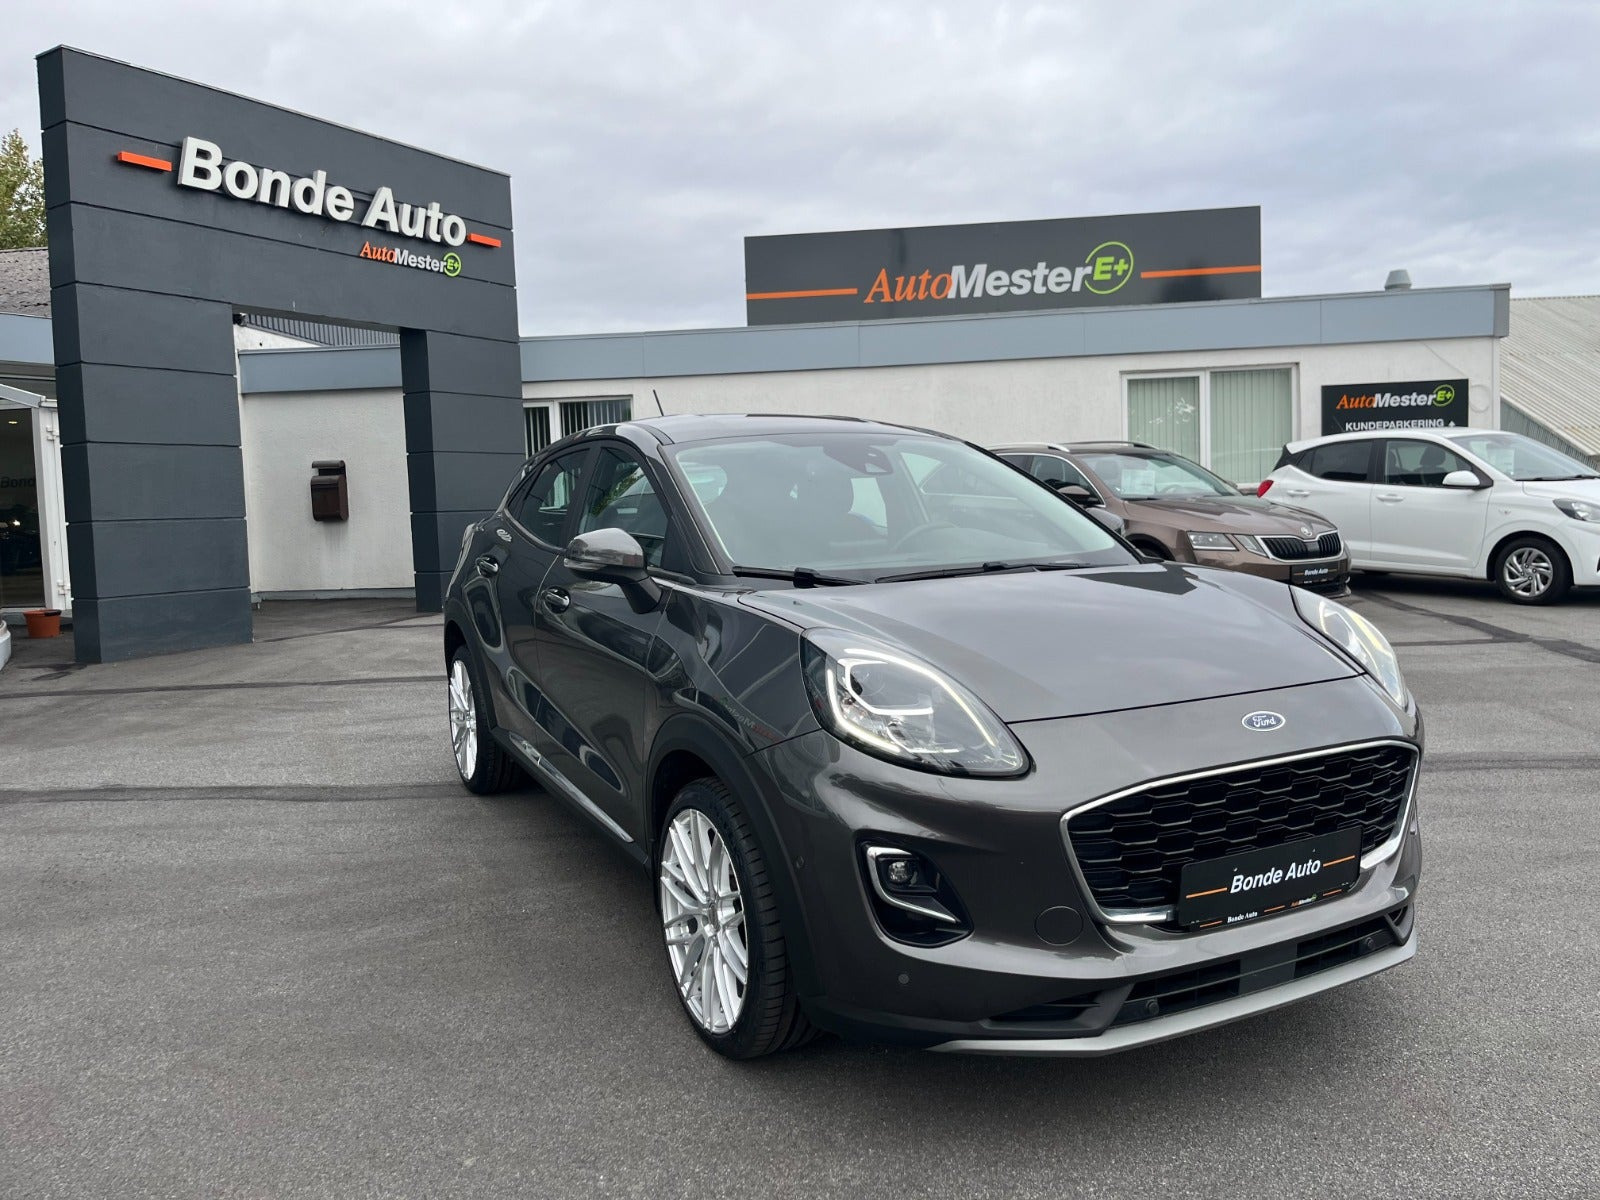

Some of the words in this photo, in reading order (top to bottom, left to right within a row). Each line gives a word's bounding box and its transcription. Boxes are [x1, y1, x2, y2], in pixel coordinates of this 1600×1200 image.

[178, 136, 355, 222] Bonde
[361, 186, 468, 248] Auto
[360, 241, 446, 273] AutoMester
[863, 261, 1091, 303] AutoMester
[1336, 392, 1436, 410] AutoMester
[1345, 418, 1445, 431] KUNDEPARKERING
[1252, 714, 1277, 728] Ford
[1230, 867, 1283, 894] Bonde
[1285, 858, 1321, 881] Auto
[1226, 913, 1245, 923] Bonde
[1245, 911, 1258, 919] Auto
